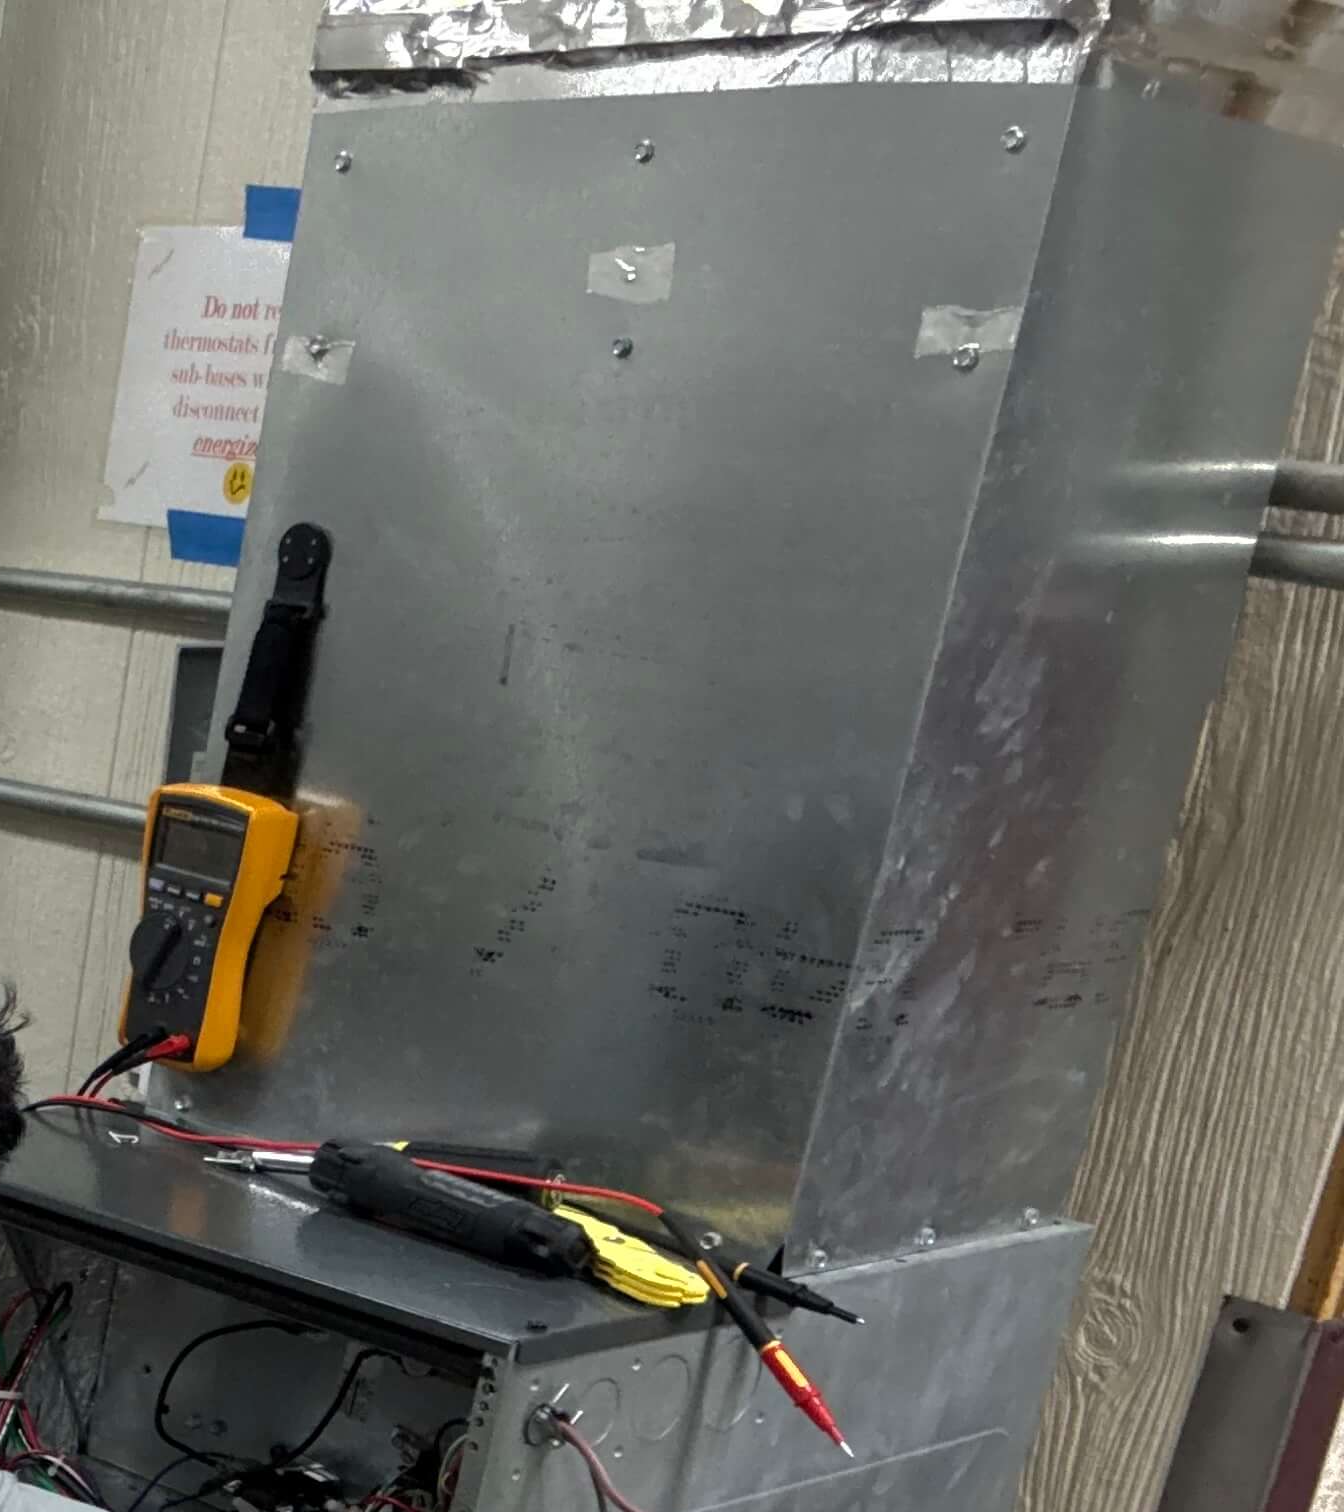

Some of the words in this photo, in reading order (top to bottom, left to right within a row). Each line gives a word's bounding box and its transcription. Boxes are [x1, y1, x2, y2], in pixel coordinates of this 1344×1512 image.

[201, 295, 226, 319] Do
[231, 301, 260, 320] not
[163, 328, 259, 353] thermostats
[172, 394, 259, 423] disconnect
